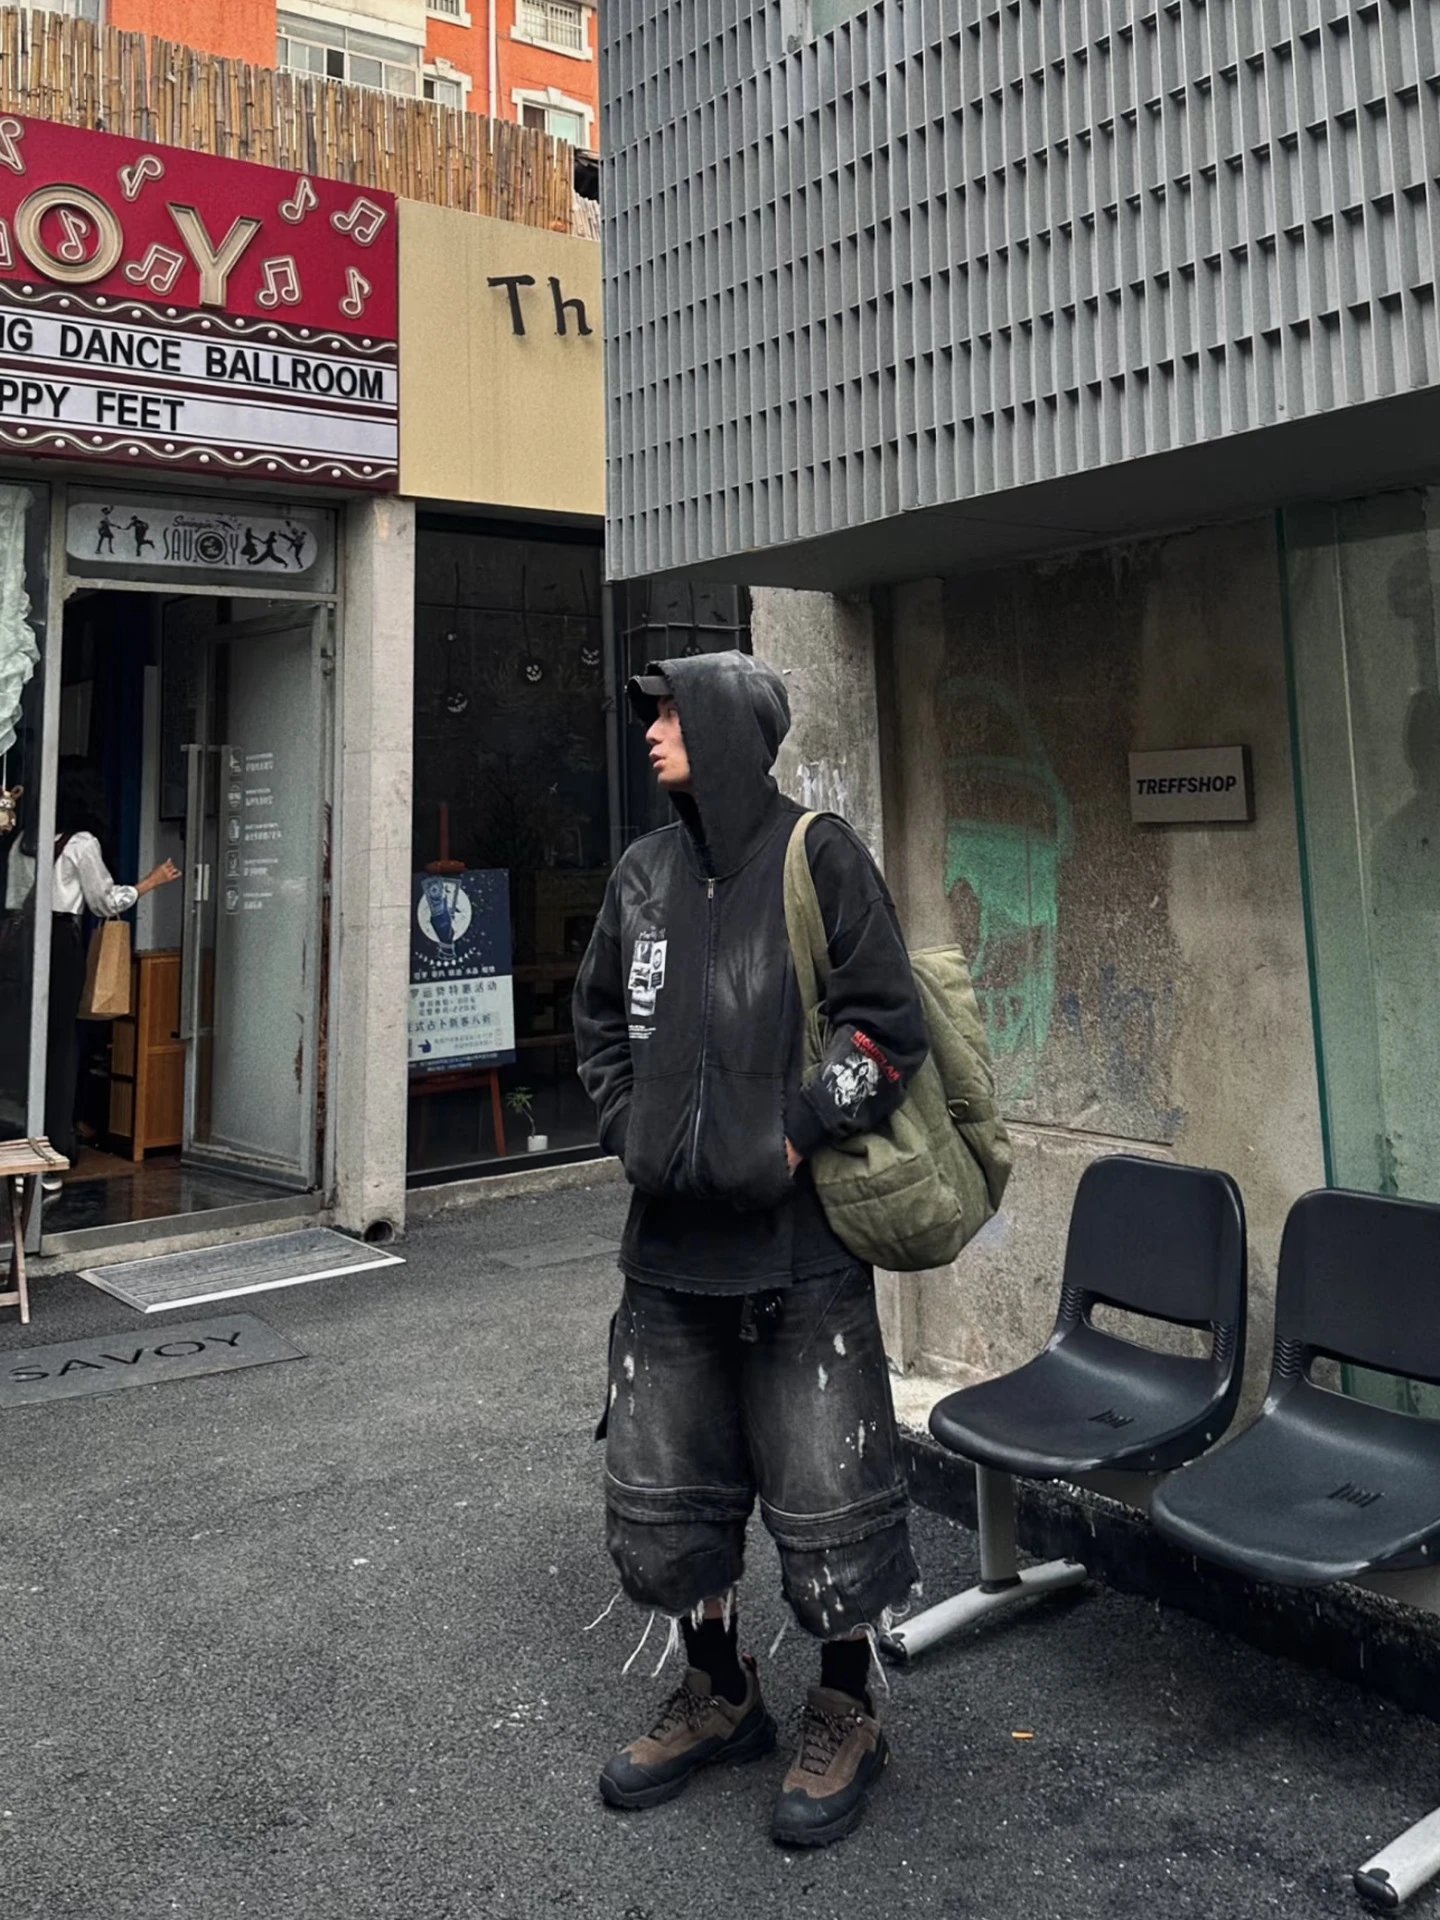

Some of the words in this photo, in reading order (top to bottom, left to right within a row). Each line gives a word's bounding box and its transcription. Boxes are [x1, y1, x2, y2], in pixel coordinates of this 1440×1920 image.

[486, 274, 593, 336] Th
[59, 324, 182, 373] DANCE
[205, 345, 384, 401] BALLROOM
[96, 389, 185, 432] FEET
[1136, 775, 1237, 795] TREFFSHOP
[9, 1331, 241, 1383] SAVOY
